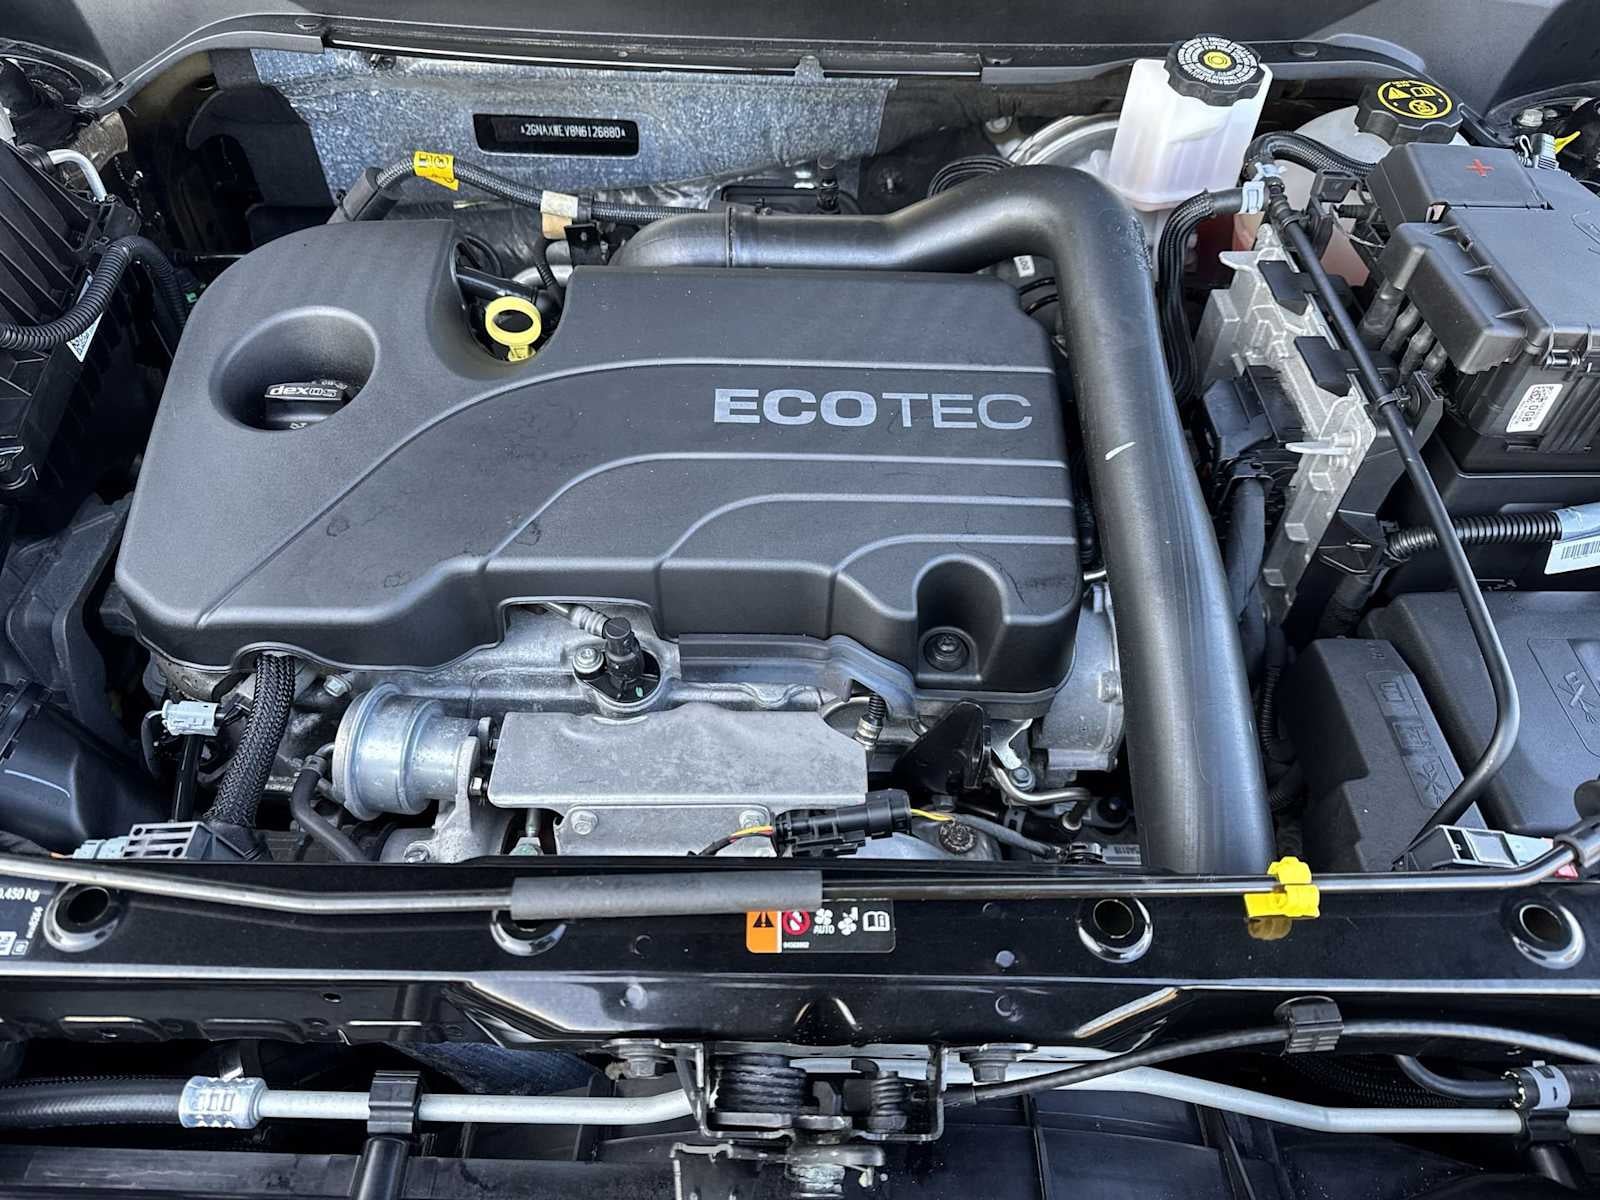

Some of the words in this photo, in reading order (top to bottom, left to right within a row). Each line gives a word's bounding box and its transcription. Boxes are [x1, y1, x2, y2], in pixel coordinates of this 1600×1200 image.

[269, 385, 338, 398] dexos
[713, 388, 1033, 430] ECOTEC
[813, 924, 836, 935] AUTO
